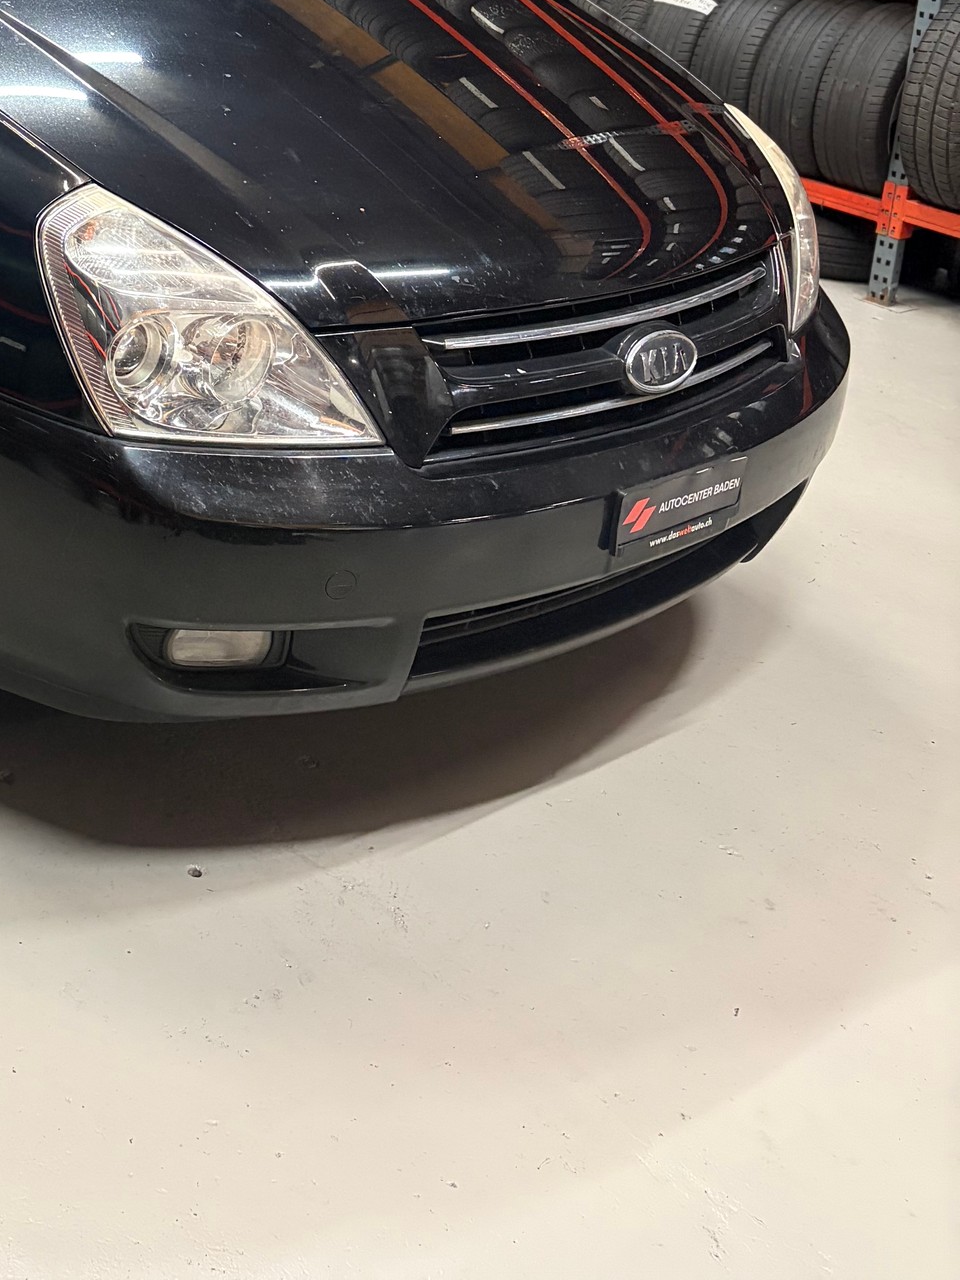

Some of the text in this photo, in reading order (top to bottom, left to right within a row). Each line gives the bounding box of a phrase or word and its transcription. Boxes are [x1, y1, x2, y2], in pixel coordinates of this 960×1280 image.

[639, 341, 689, 383] KIA
[658, 477, 741, 514] AUTOCENTER BADEN
